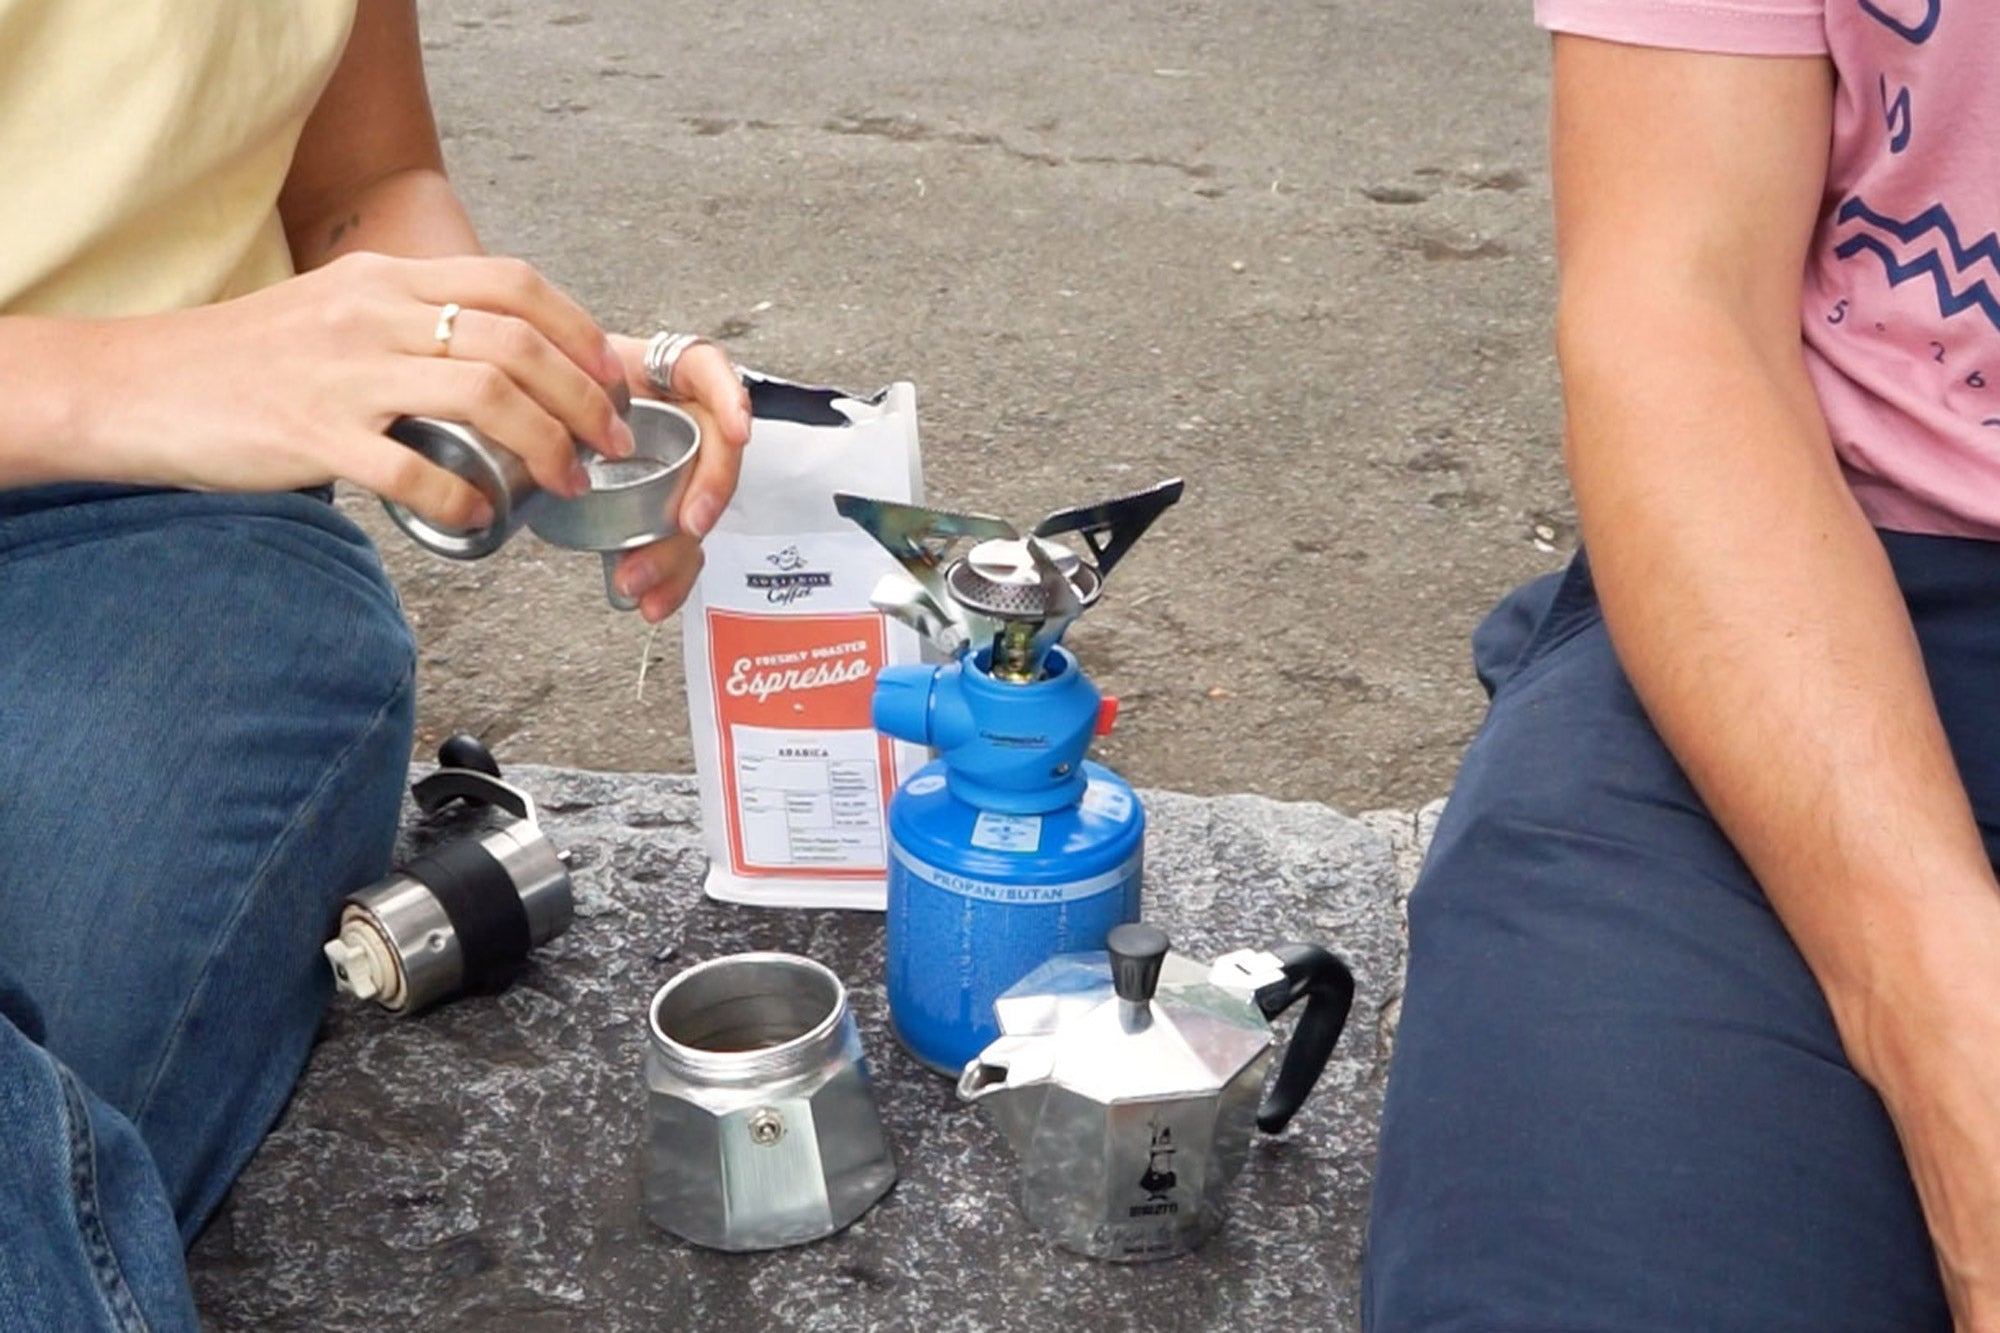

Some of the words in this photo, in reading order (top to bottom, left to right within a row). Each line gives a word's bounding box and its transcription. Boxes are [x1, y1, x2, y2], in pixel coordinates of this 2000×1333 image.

[1827, 299, 1850, 325] 5
[1965, 371, 1986, 389] 6
[755, 651, 808, 666] FRESHLY
[726, 658, 871, 702] Espresso
[778, 748, 829, 758] ARABICA
